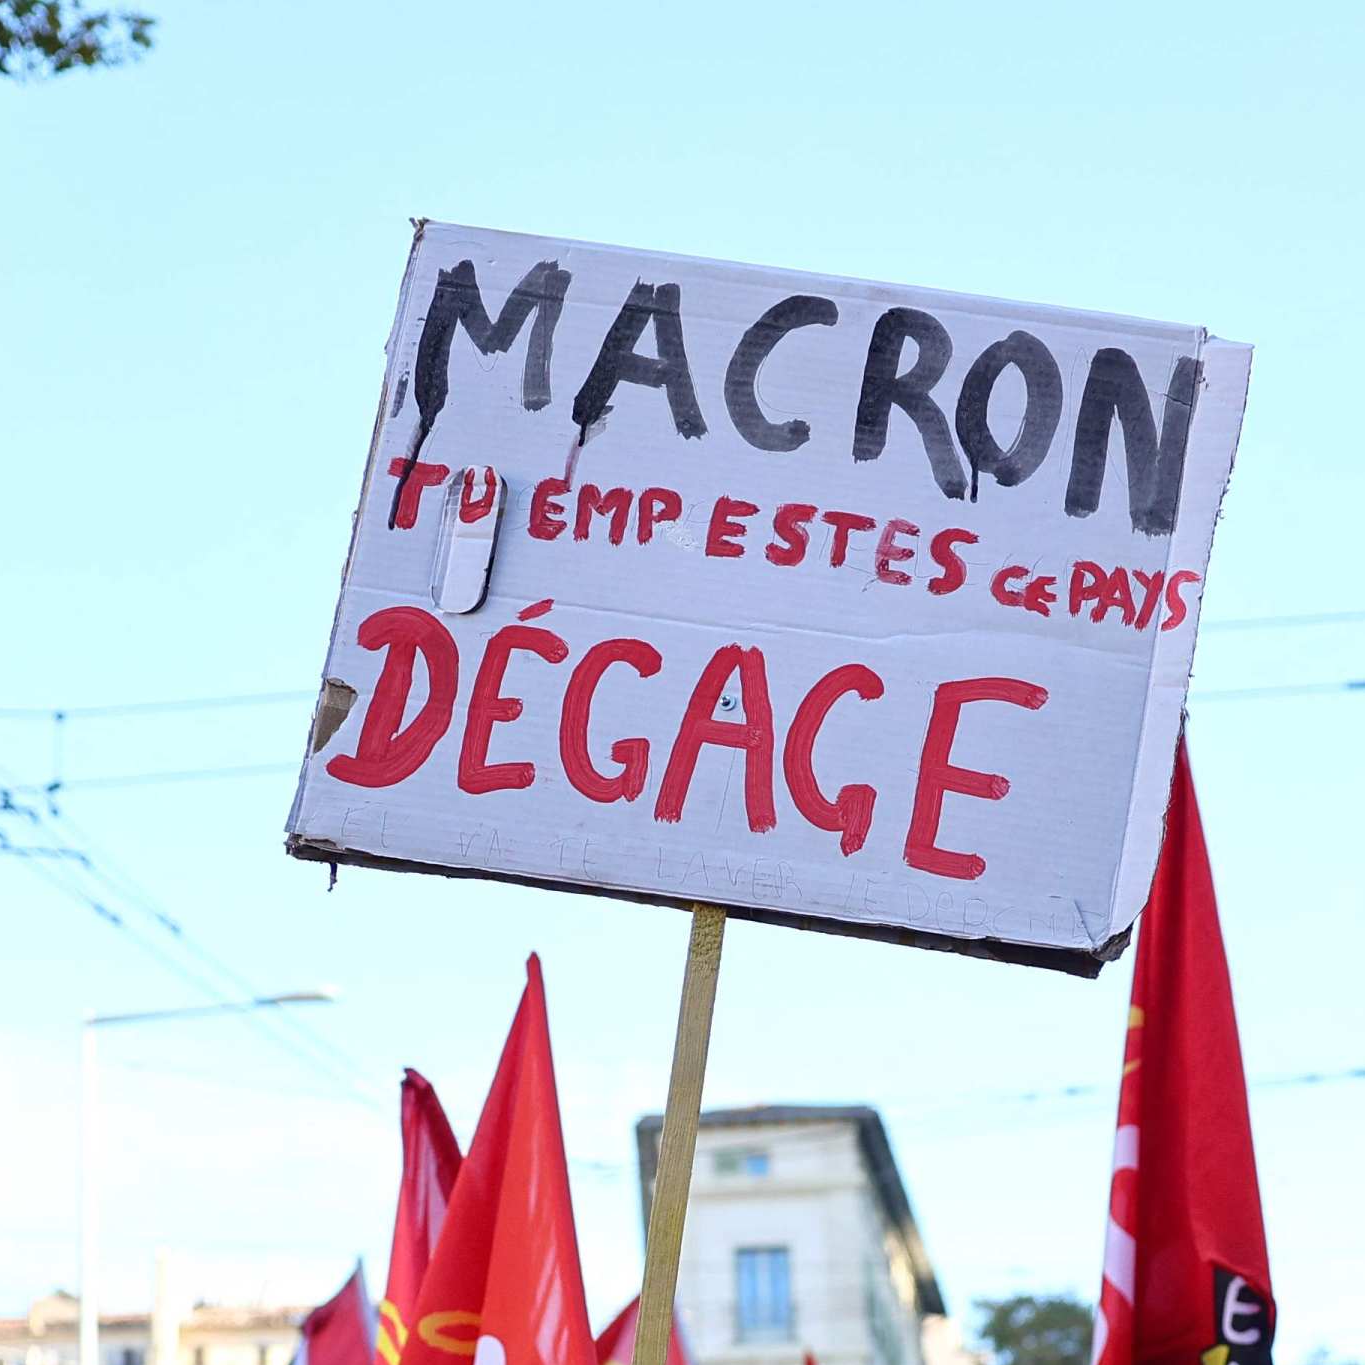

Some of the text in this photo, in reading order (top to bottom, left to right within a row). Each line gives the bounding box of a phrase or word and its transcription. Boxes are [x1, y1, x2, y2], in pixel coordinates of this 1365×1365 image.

[403, 258, 1205, 535] MACRON
[387, 457, 496, 532] TU
[990, 564, 1058, 617] CE
[1068, 558, 1202, 632] PAYS
[325, 599, 1049, 880] DÉGAGE
